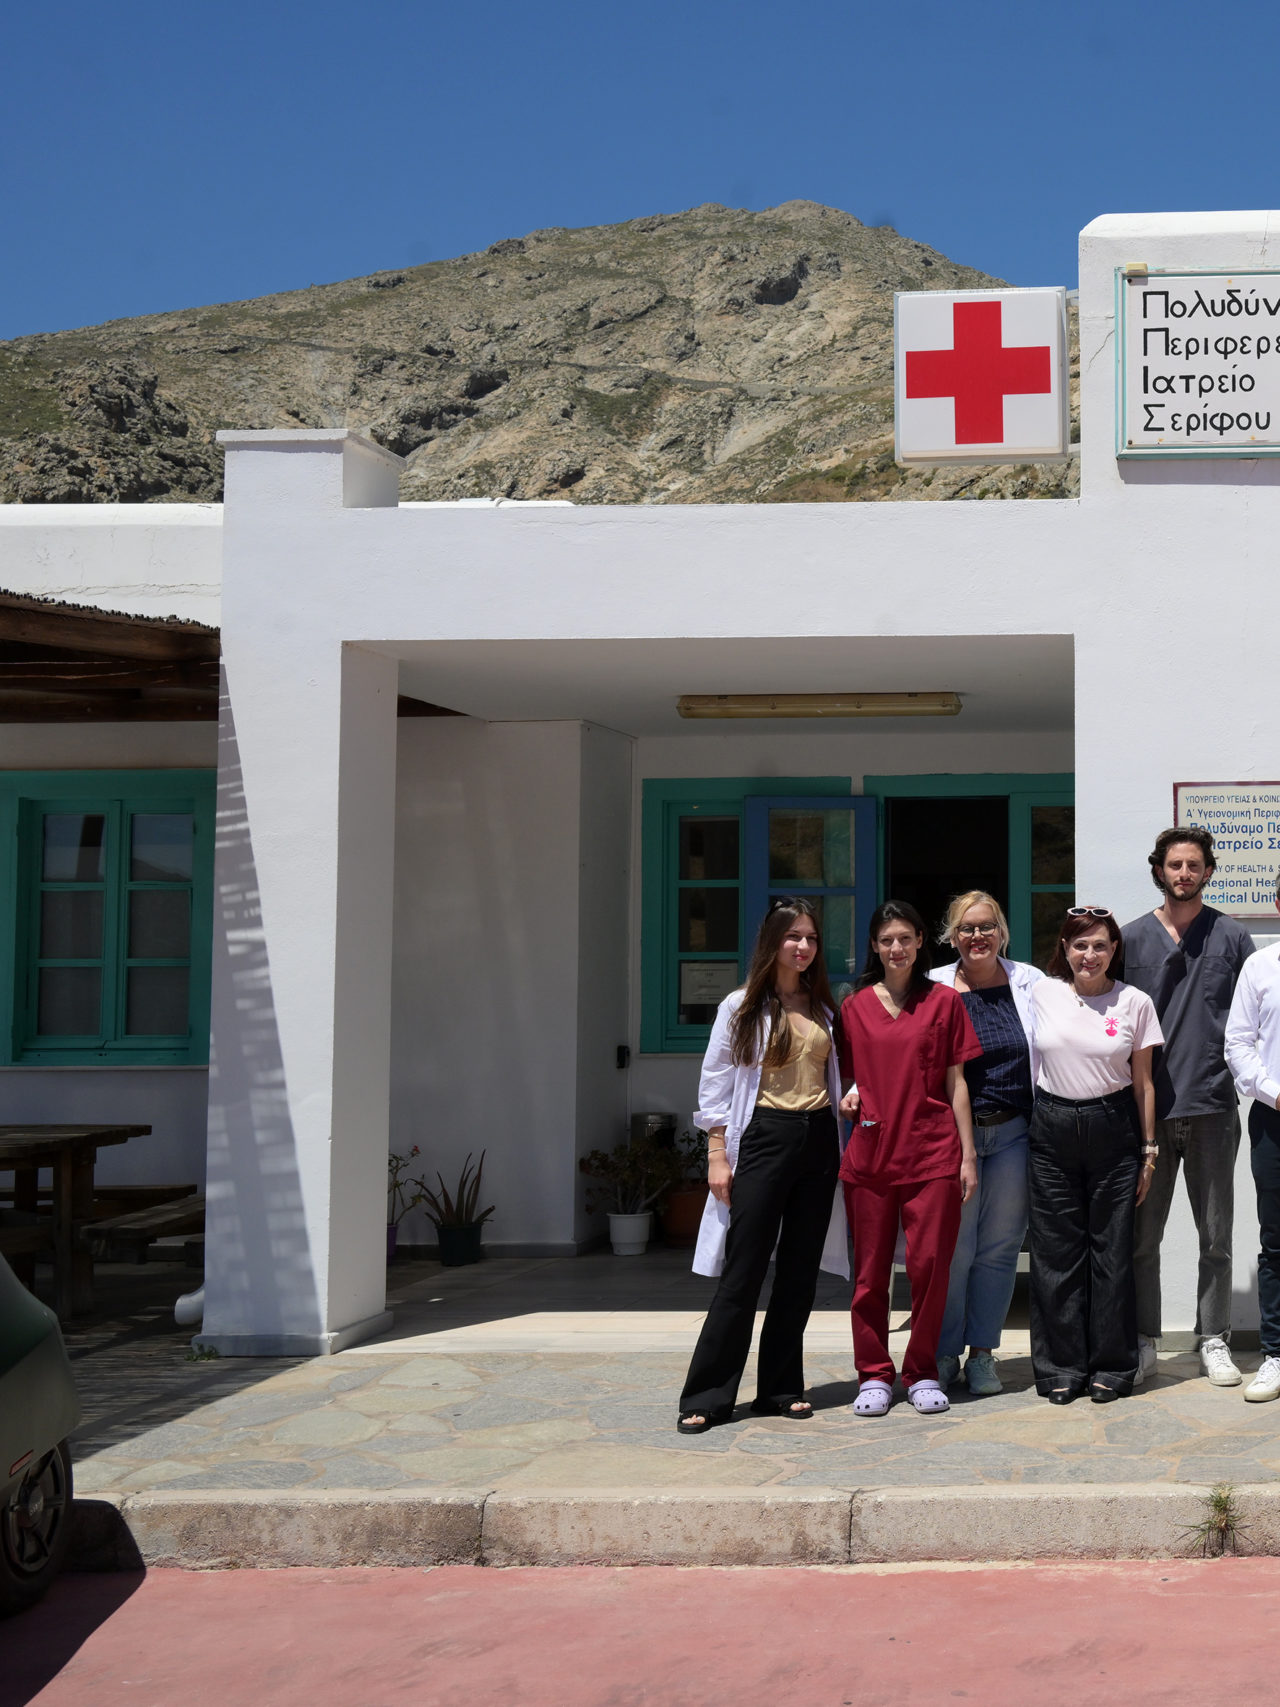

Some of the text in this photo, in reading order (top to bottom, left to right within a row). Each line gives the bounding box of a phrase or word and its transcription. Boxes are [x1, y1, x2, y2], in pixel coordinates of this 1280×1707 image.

[1143, 364, 1256, 398] Ιατρείο
[1143, 403, 1271, 436] Σερίφου
[1185, 795, 1225, 804] ΥΠΟΥΡΓΕΙΟ
[1226, 795, 1251, 804] ΥΓΕΙΑΣ
[1252, 795, 1257, 803] &
[1212, 837, 1263, 852] Ιατρείο
